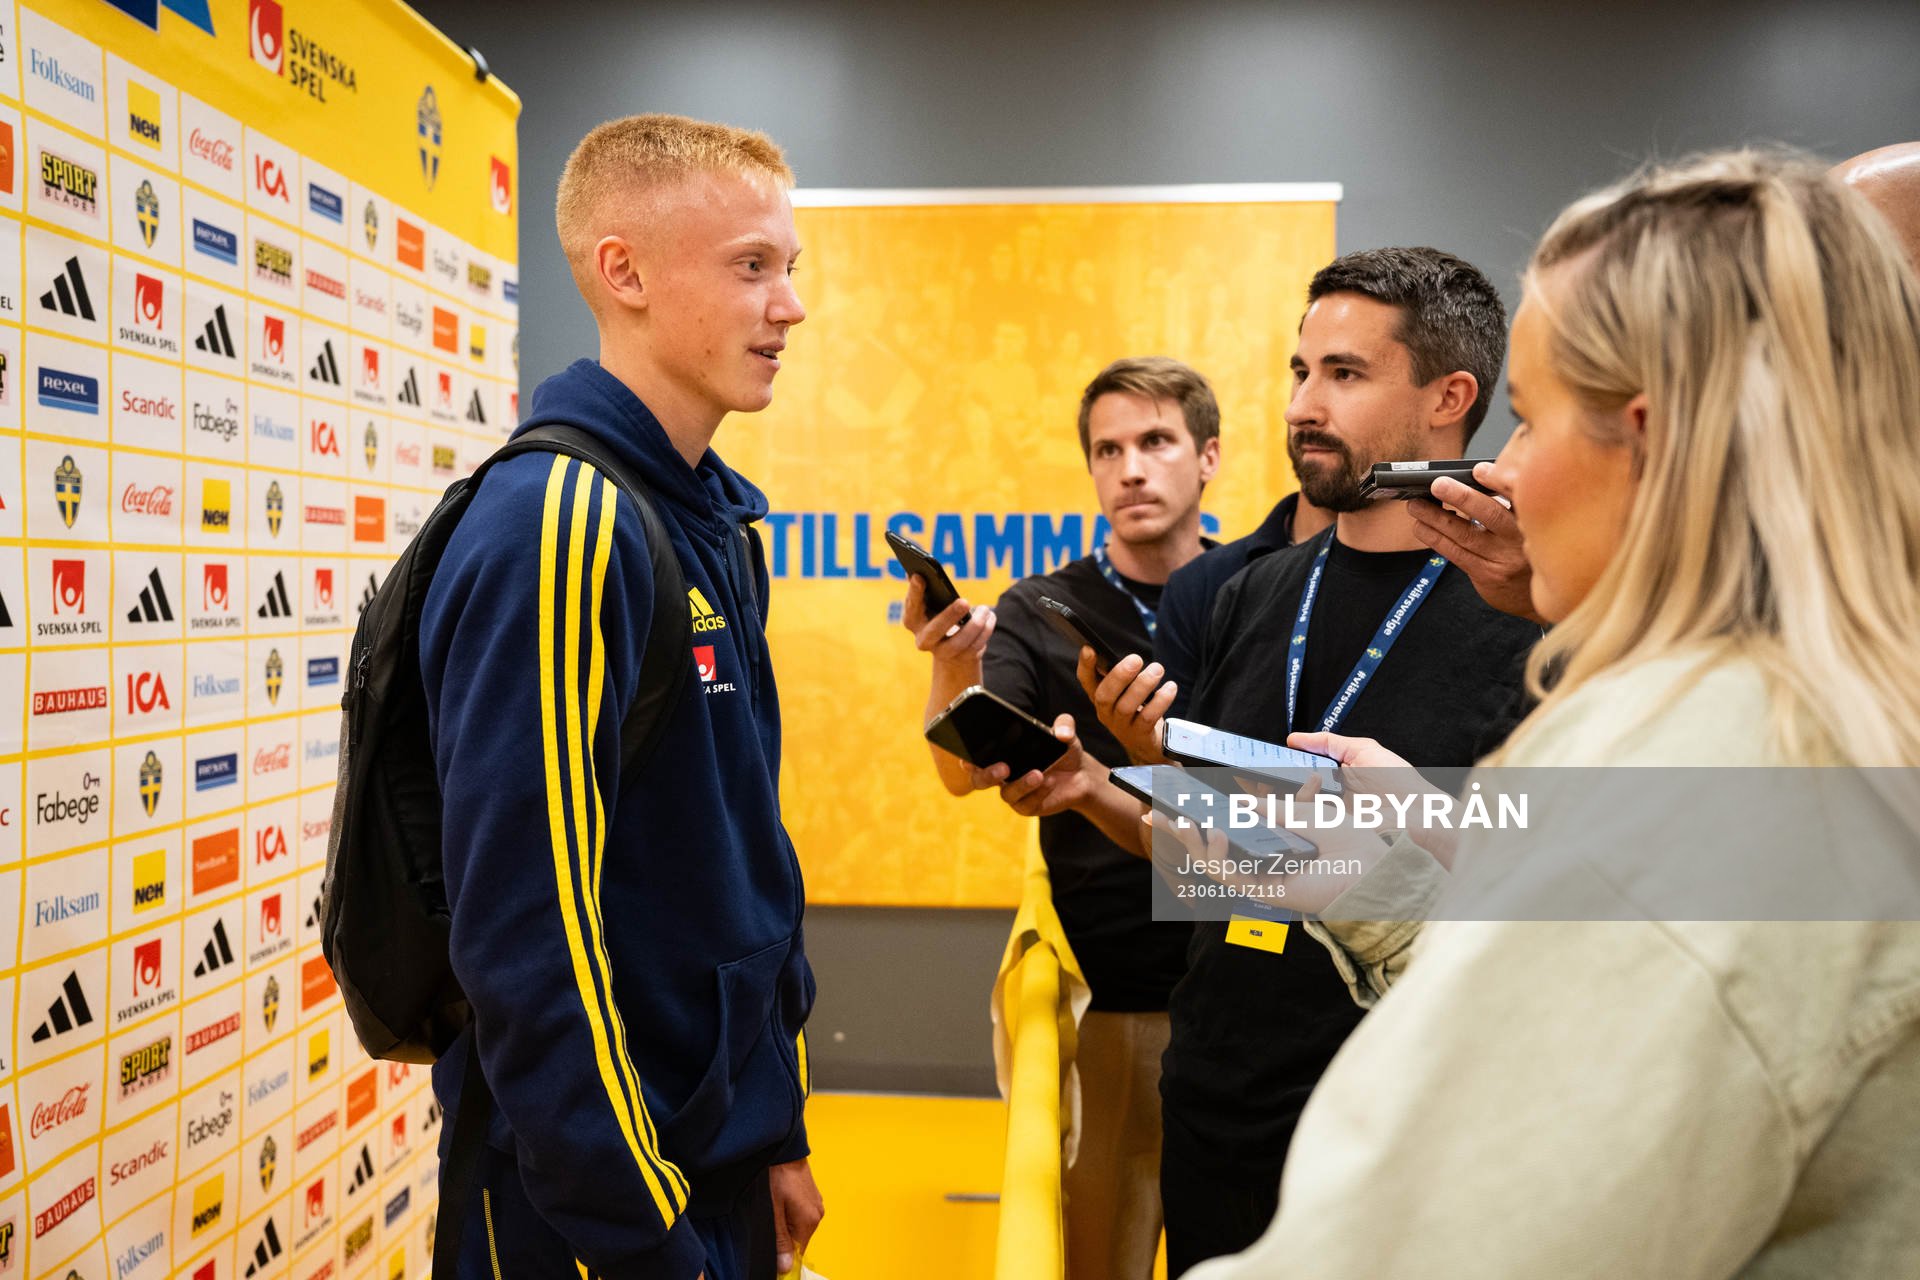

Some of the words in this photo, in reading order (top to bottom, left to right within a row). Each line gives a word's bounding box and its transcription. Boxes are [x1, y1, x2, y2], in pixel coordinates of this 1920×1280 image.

[31, 48, 95, 102] Folksam
[290, 29, 357, 93] SVENSKA
[290, 61, 326, 103] SPEL
[41, 151, 97, 203] SPORT
[255, 153, 290, 203] ICA
[45, 187, 96, 213] BLADET
[119, 328, 157, 348] SVENSKA
[159, 337, 177, 353] SPEL
[122, 390, 176, 420] Scandic
[193, 402, 238, 442] Fabege
[311, 419, 340, 458] ICA
[692, 615, 726, 633] idas
[1384, 578, 1430, 636] #viärsverige
[37, 622, 78, 636] SVENSKA
[81, 621, 102, 634] SPEL
[35, 688, 106, 713] BAUHAUS
[127, 672, 170, 714] ICA
[713, 683, 736, 693] SPEL
[37, 791, 99, 825] Fabege
[256, 825, 288, 864] ICA
[34, 893, 99, 928] Folksam
[117, 999, 155, 1023] SVENSKA
[157, 989, 175, 1008] SPEL
[121, 1036, 171, 1087] SPORT
[187, 1108, 233, 1148] Fabege
[110, 1141, 168, 1186] Scandic
[36, 1180, 95, 1237] BAUHAUS
